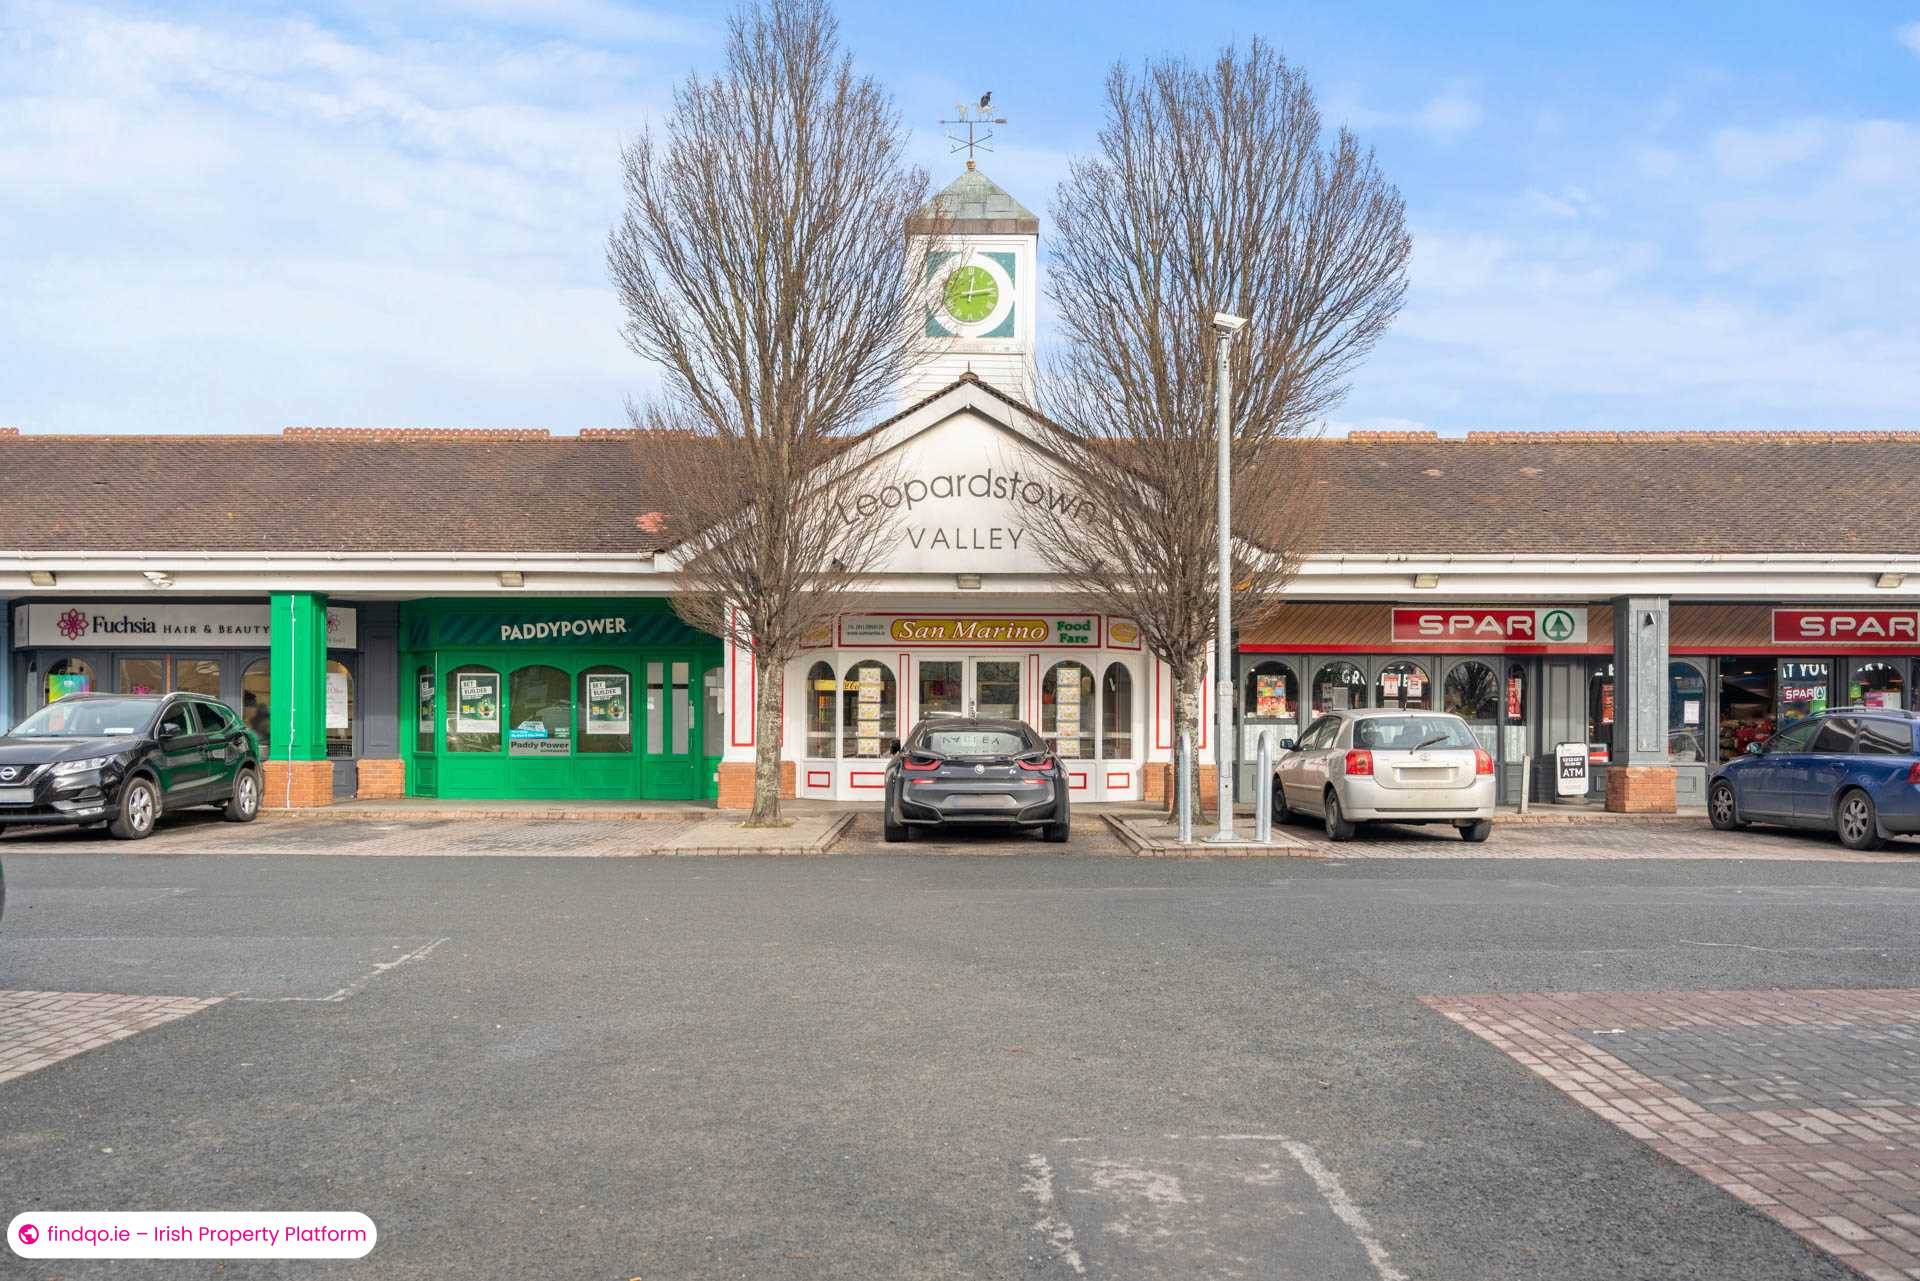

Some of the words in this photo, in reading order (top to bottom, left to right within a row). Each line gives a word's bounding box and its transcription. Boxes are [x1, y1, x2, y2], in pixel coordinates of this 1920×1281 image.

[834, 468, 1098, 526] Leopardstown
[907, 528, 1025, 550] VALLEY
[92, 615, 157, 634] Fuchsia
[163, 624, 197, 634] HAIR
[203, 624, 212, 634] &
[218, 624, 271, 634] BEAUTY
[501, 617, 628, 641] PADDYPOWER
[899, 621, 946, 640] San
[952, 621, 1045, 640] Marino
[1056, 620, 1092, 632] Food
[1418, 615, 1533, 636] SPAR
[1800, 616, 1916, 637] SPAR
[1059, 634, 1089, 644] Fare
[1785, 689, 1815, 700] SPAR
[511, 741, 539, 751] Paddy
[540, 741, 569, 749] Power
[1562, 767, 1584, 778] ATM
